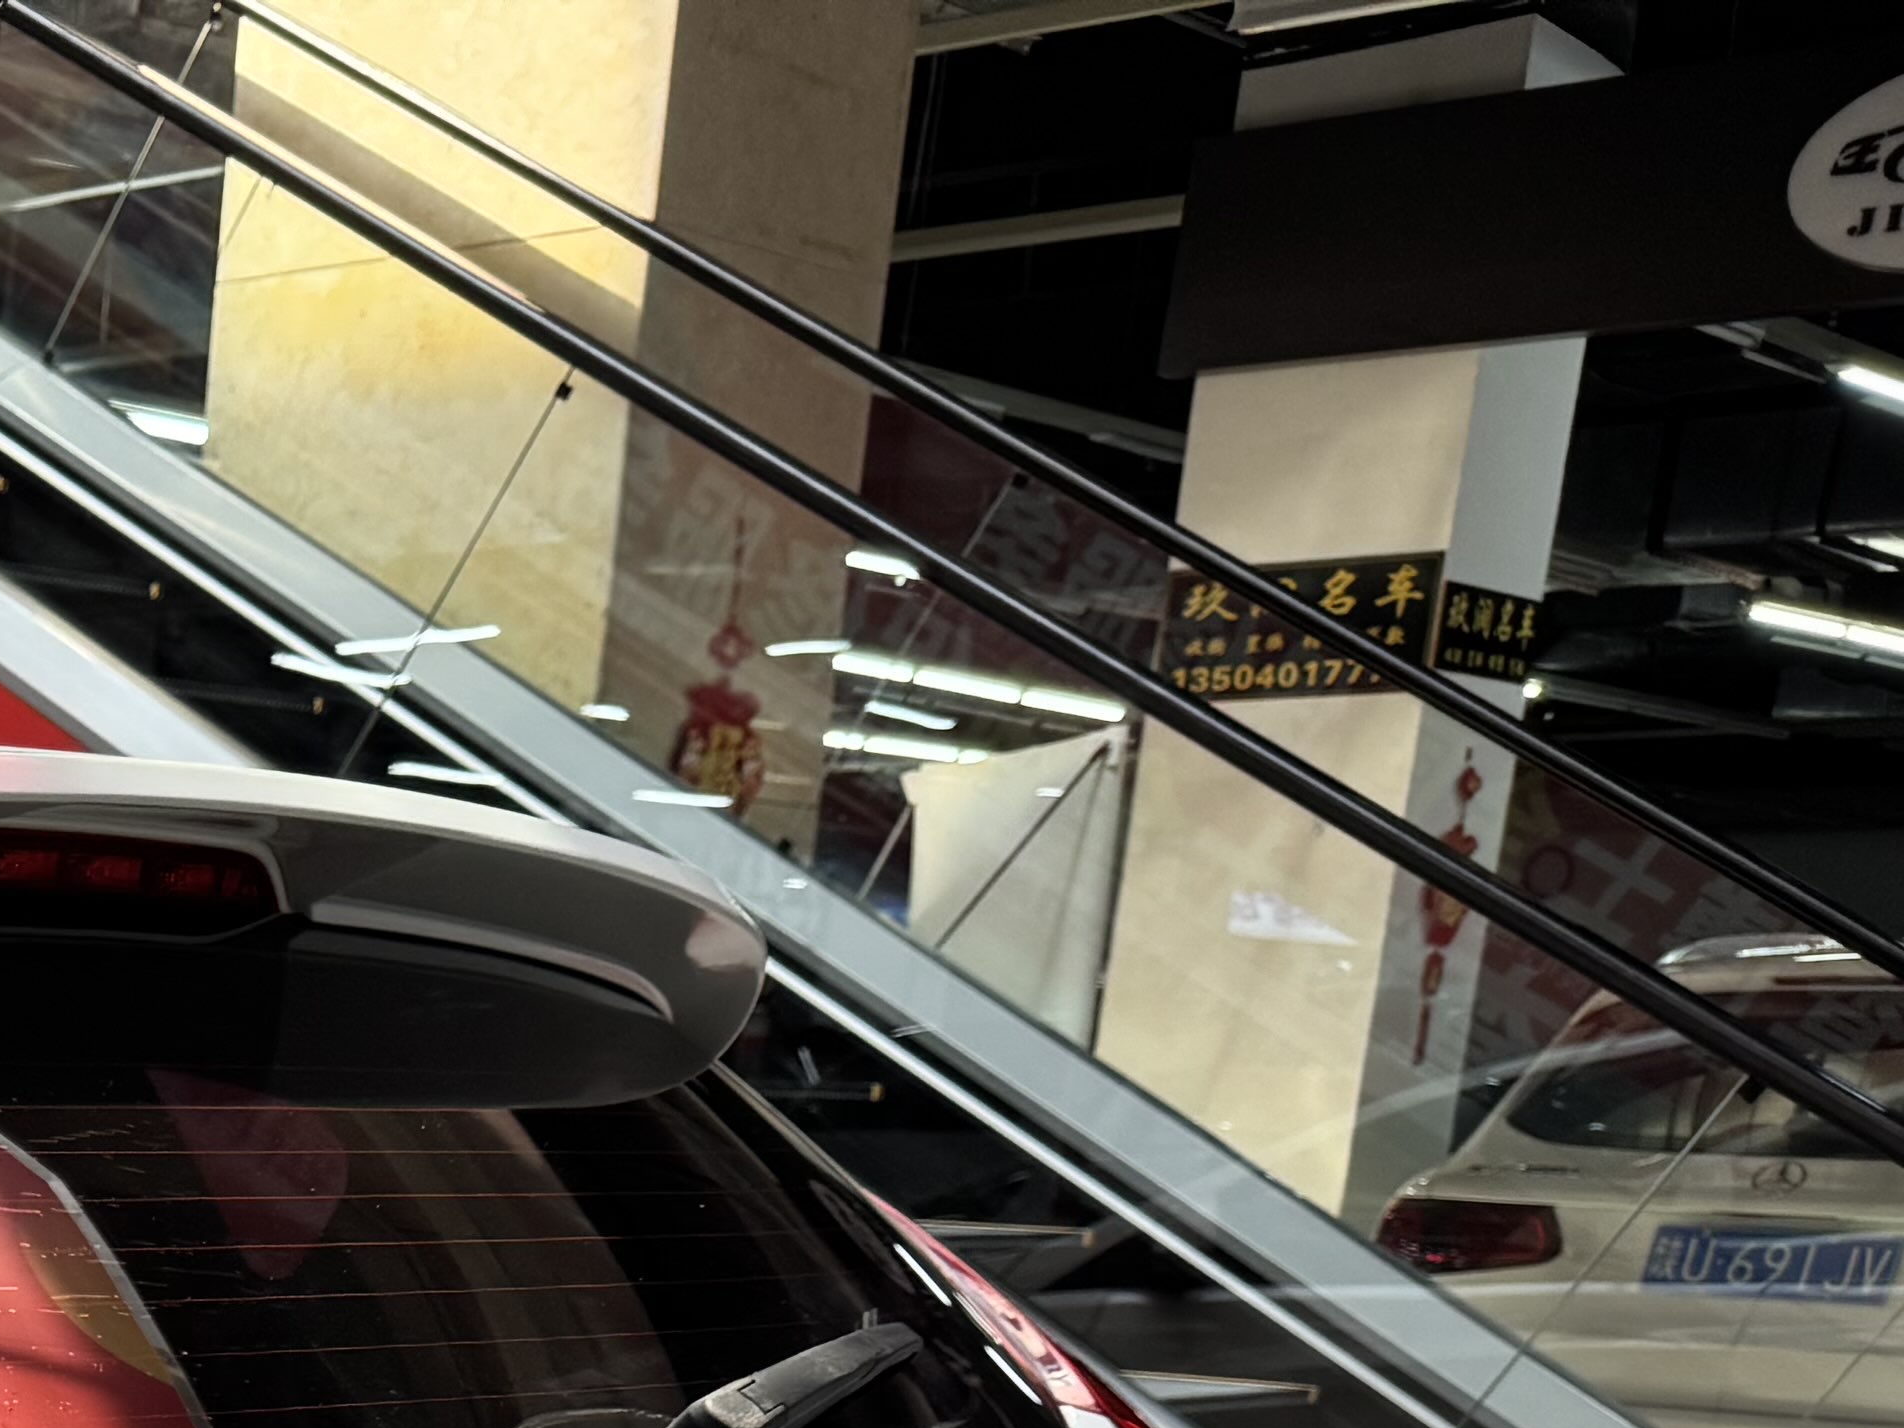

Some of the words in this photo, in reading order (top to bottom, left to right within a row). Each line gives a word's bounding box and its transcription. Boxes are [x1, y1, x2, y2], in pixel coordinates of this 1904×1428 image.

[1181, 562, 1425, 622] 玖名车
[1172, 658, 1382, 694] 135040177
